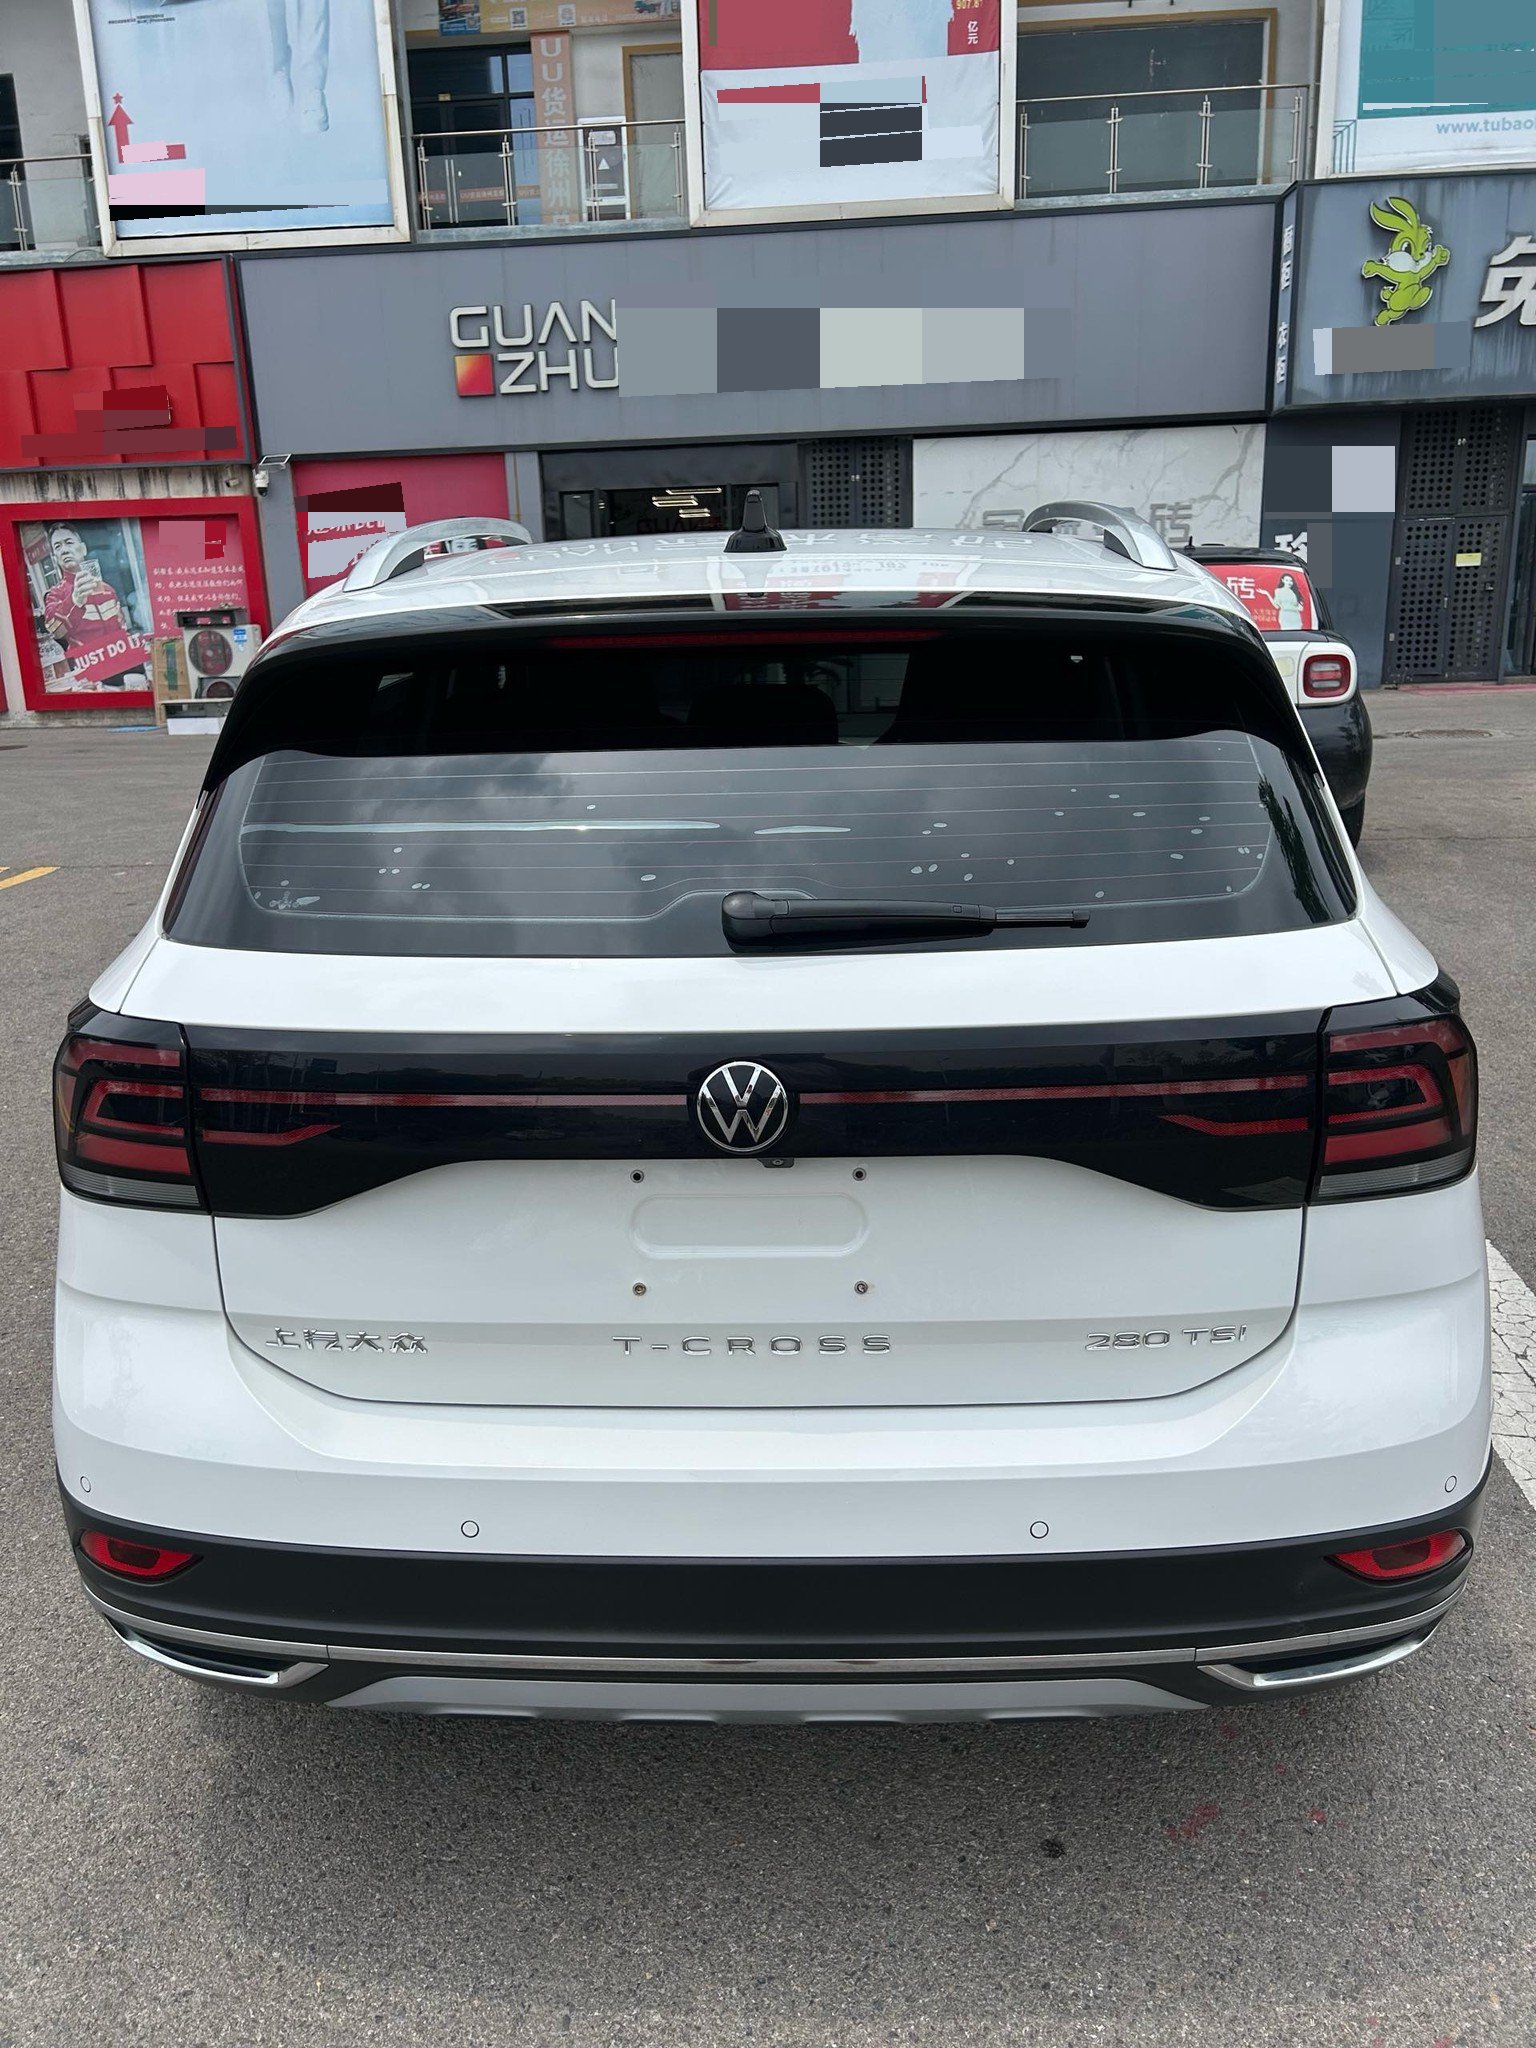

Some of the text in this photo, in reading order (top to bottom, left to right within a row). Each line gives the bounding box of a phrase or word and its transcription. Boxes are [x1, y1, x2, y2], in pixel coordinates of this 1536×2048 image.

[967, 20, 979, 45] 亿元
[449, 298, 618, 348] GUAN
[496, 347, 620, 394] ZHU
[73, 647, 106, 671] JUST
[107, 639, 127, 658] DO
[265, 1327, 428, 1353] 上汽大众
[611, 1334, 891, 1356] T-CROSS
[1085, 1324, 1248, 1351] 280 TSI
